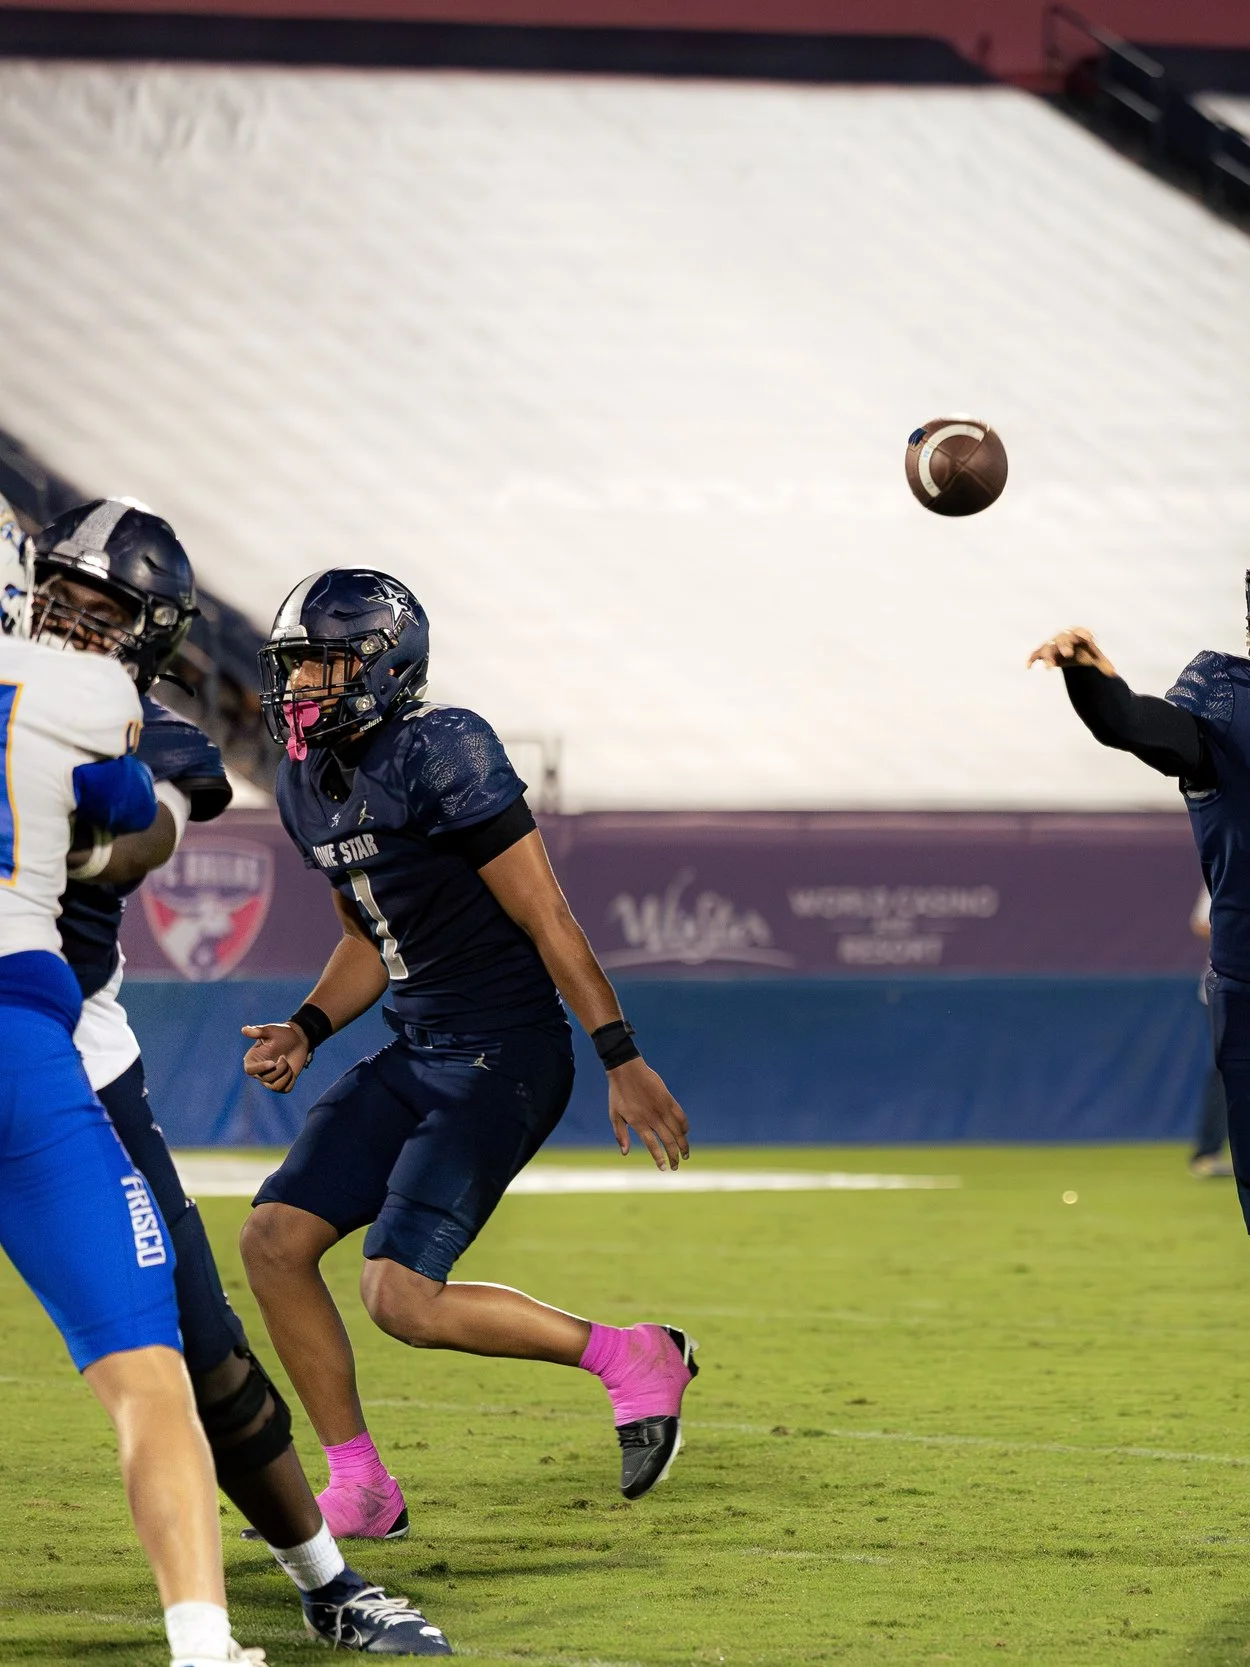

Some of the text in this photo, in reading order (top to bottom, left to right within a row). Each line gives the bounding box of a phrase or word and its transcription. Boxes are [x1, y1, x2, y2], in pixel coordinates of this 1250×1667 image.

[340, 833, 379, 864] STAR
[347, 869, 408, 980] 1
[121, 1175, 166, 1268] FRISCO
